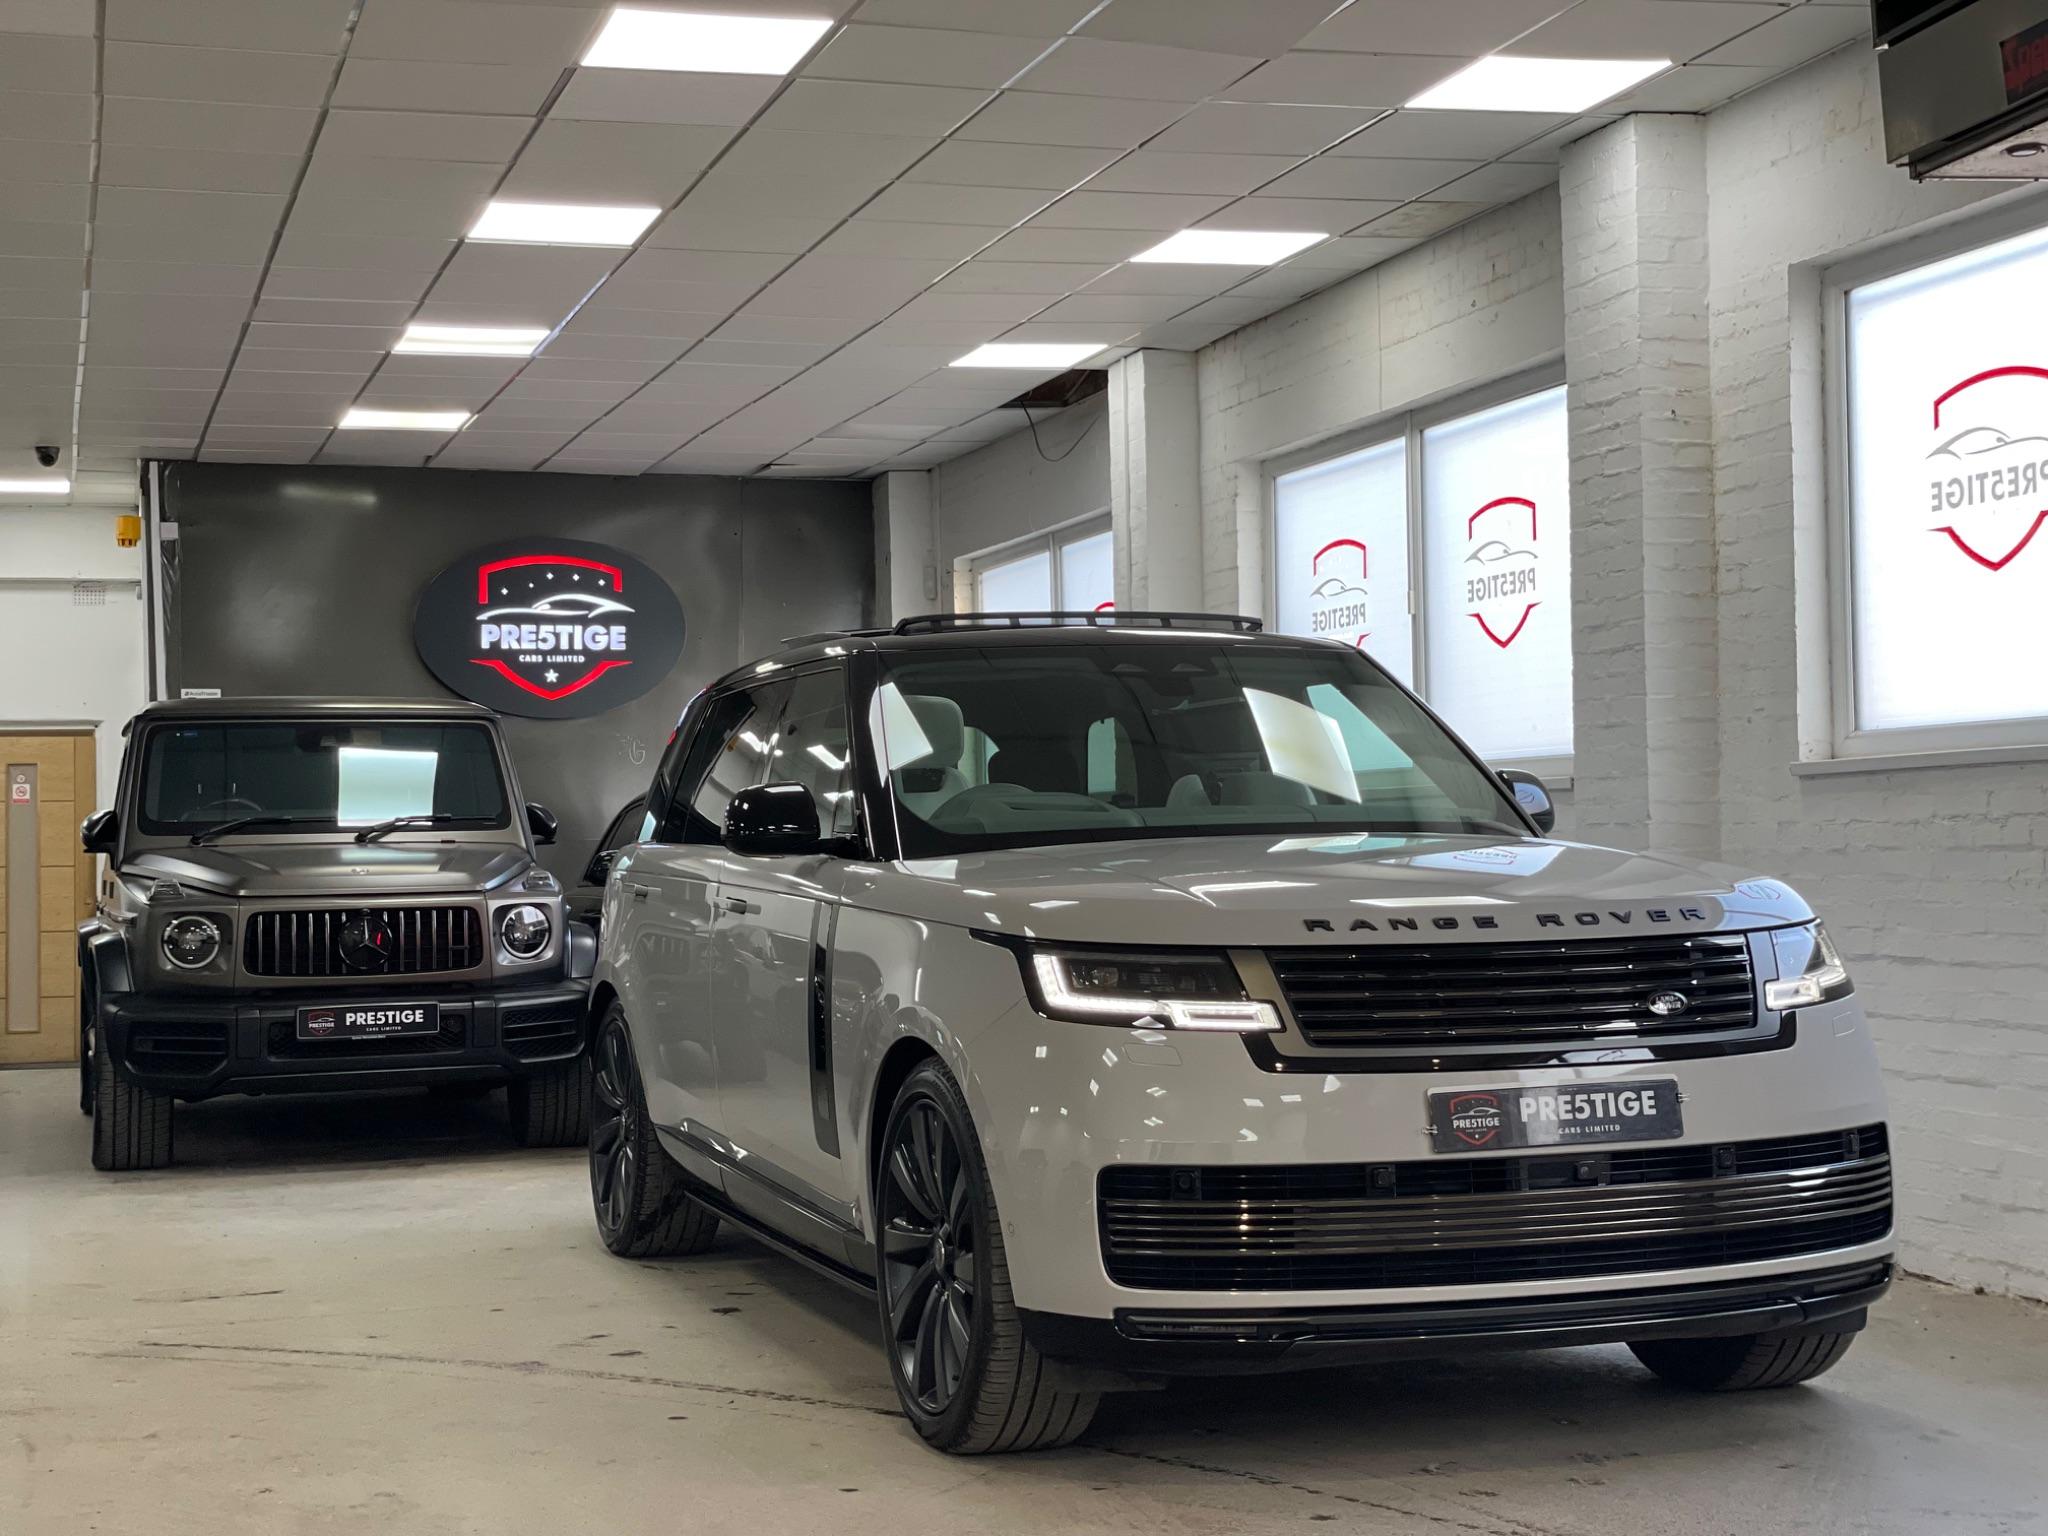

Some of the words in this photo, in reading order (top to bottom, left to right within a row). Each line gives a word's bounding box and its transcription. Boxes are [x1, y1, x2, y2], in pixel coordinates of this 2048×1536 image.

[546, 654, 586, 663] LIMITED
[1303, 915, 1499, 932] RANGE
[1536, 907, 1706, 928] ROVER
[1585, 1124, 1621, 1133] LIMITED
